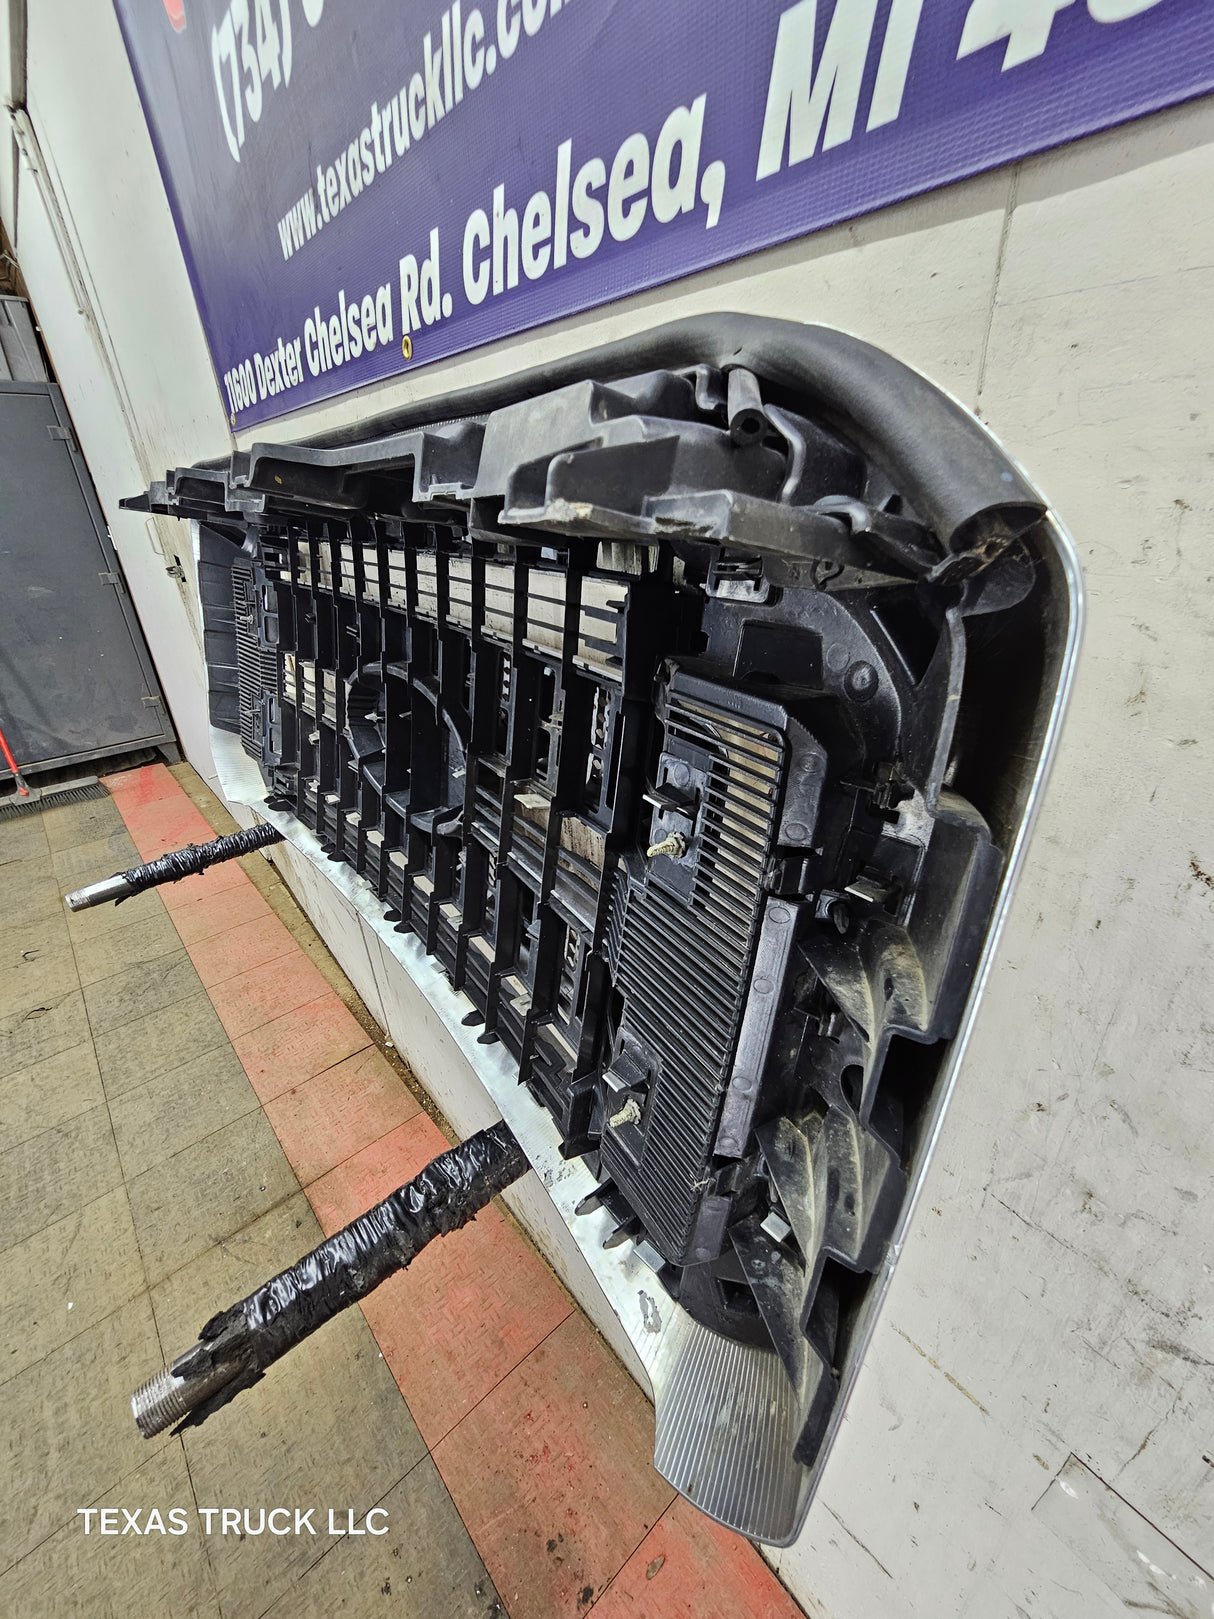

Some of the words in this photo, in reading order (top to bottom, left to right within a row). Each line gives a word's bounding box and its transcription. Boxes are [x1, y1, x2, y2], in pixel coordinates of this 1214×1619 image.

[223, 358, 257, 414] 11600
[253, 336, 305, 401] Dexter
[303, 282, 394, 378] Chelsea
[399, 227, 453, 336] Rd.
[462, 93, 726, 304] Chelsea,
[755, 0, 923, 182] MI
[277, 0, 571, 262] www.texastruckllc.c
